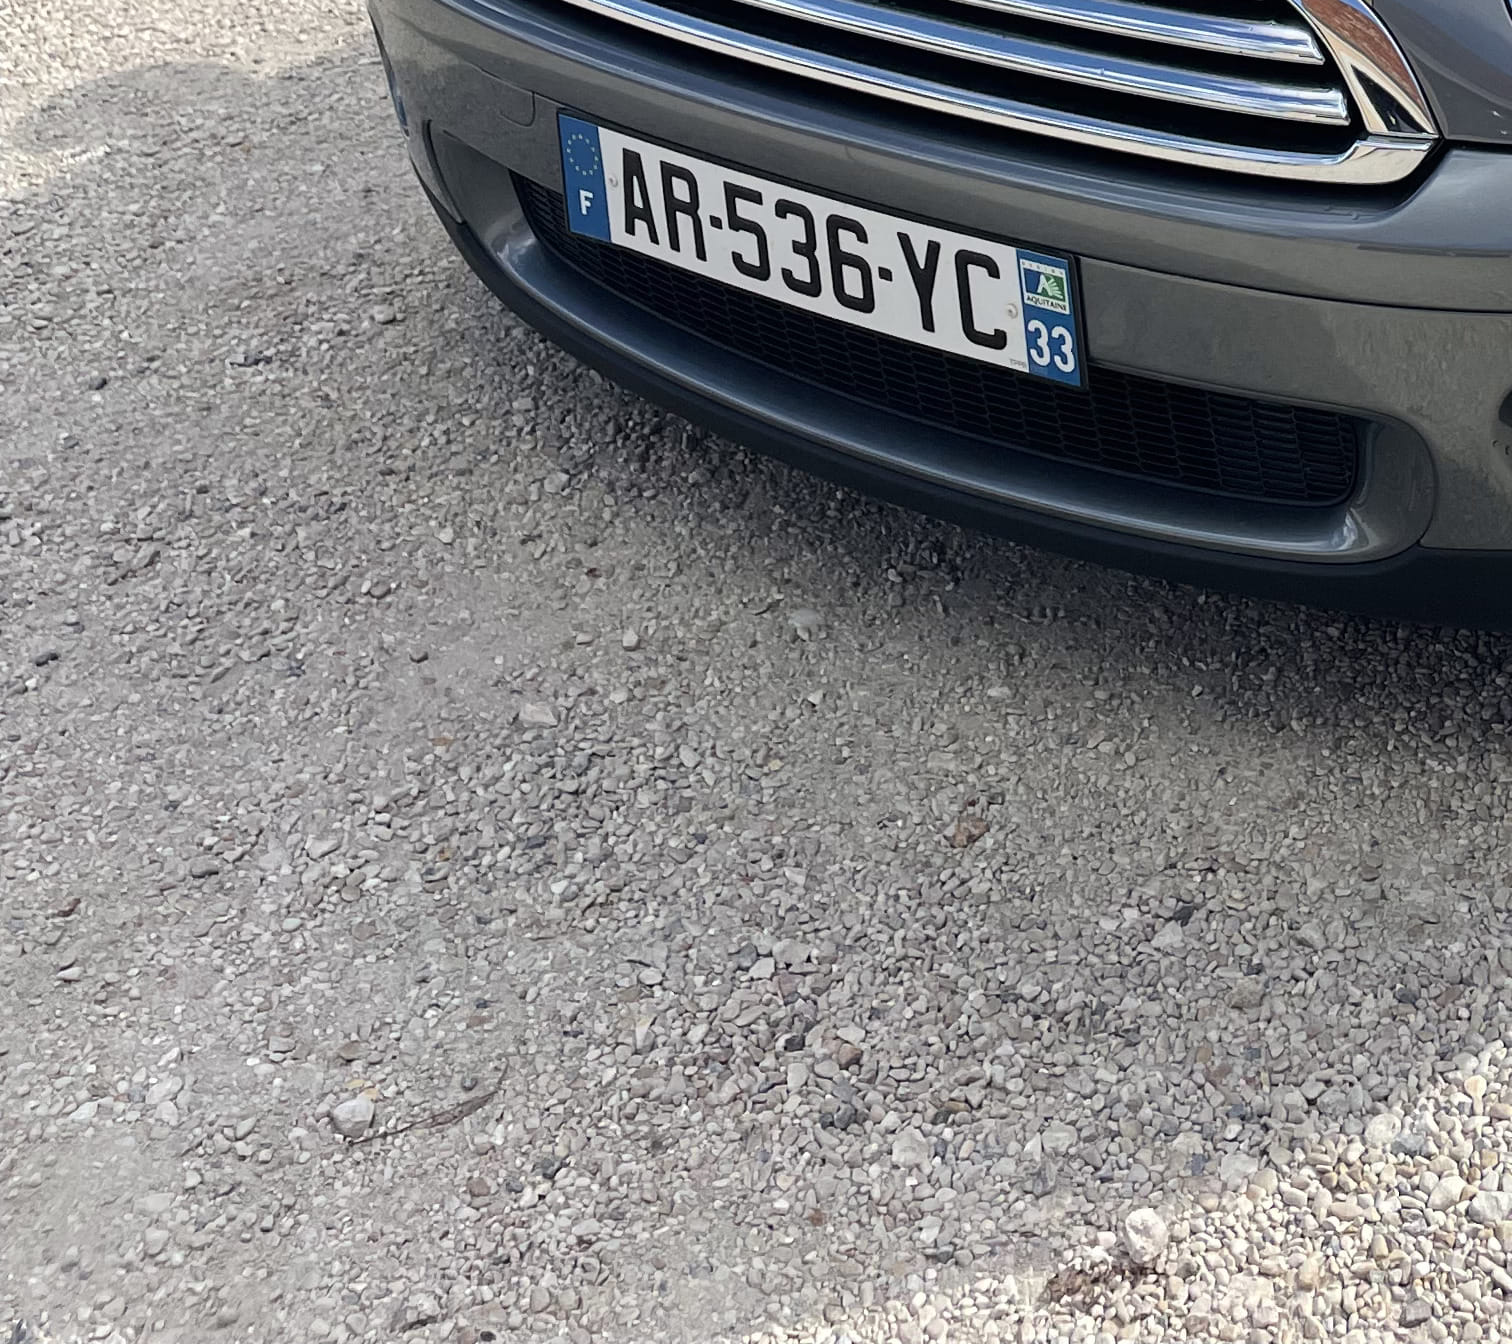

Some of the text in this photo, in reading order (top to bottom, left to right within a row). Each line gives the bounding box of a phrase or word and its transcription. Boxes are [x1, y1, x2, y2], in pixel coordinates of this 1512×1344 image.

[578, 188, 594, 216] F
[622, 147, 1007, 351] AR-536-YC
[1026, 294, 1067, 312] AQUITAINE
[1027, 318, 1076, 373] 33
